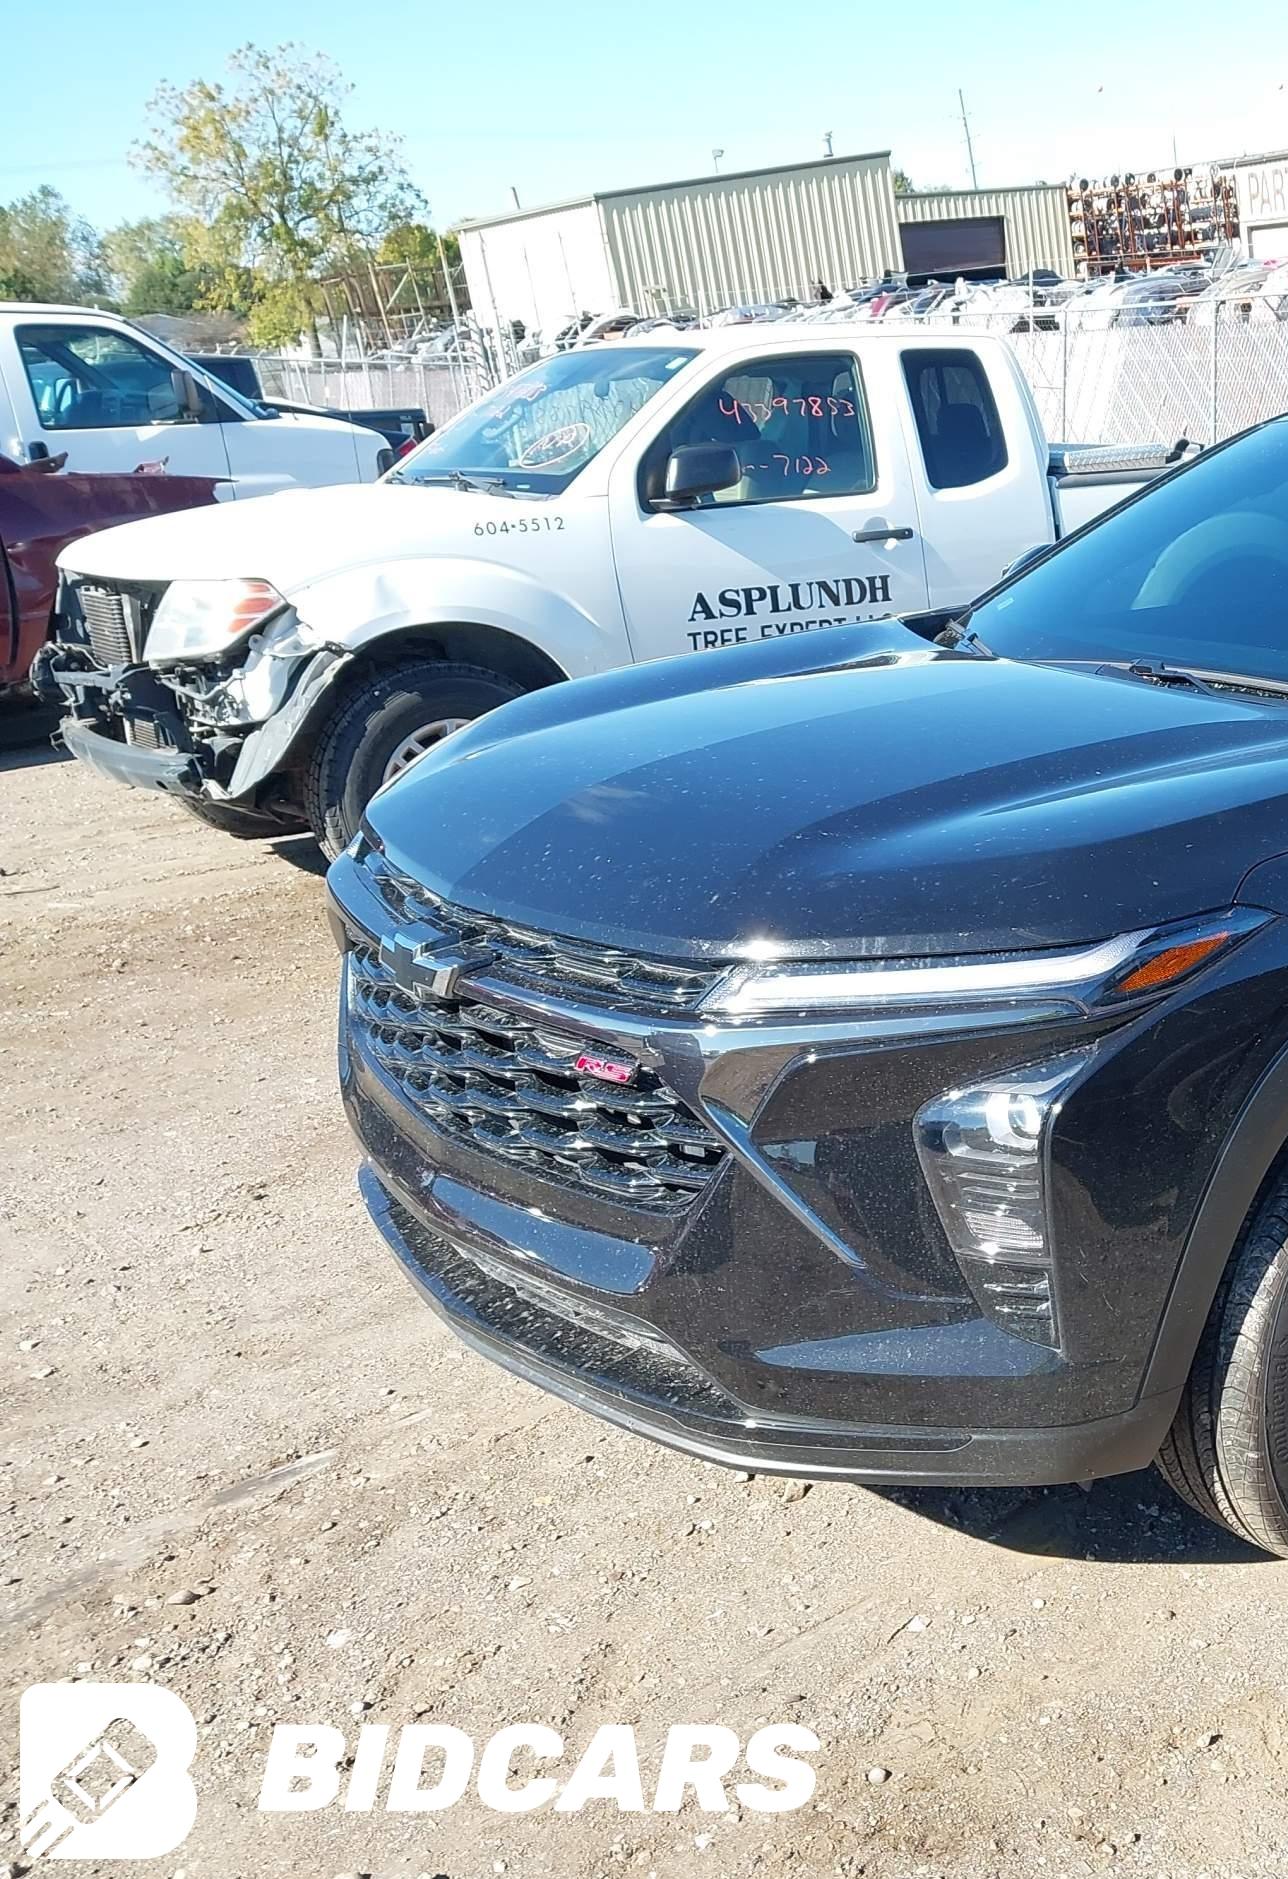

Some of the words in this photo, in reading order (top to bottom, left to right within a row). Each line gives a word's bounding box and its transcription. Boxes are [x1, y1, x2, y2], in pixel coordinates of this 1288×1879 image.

[687, 573, 893, 622] ASPLUNDH
[687, 626, 748, 651] TREE
[760, 616, 847, 638] EXP
[575, 1055, 633, 1083] RS
